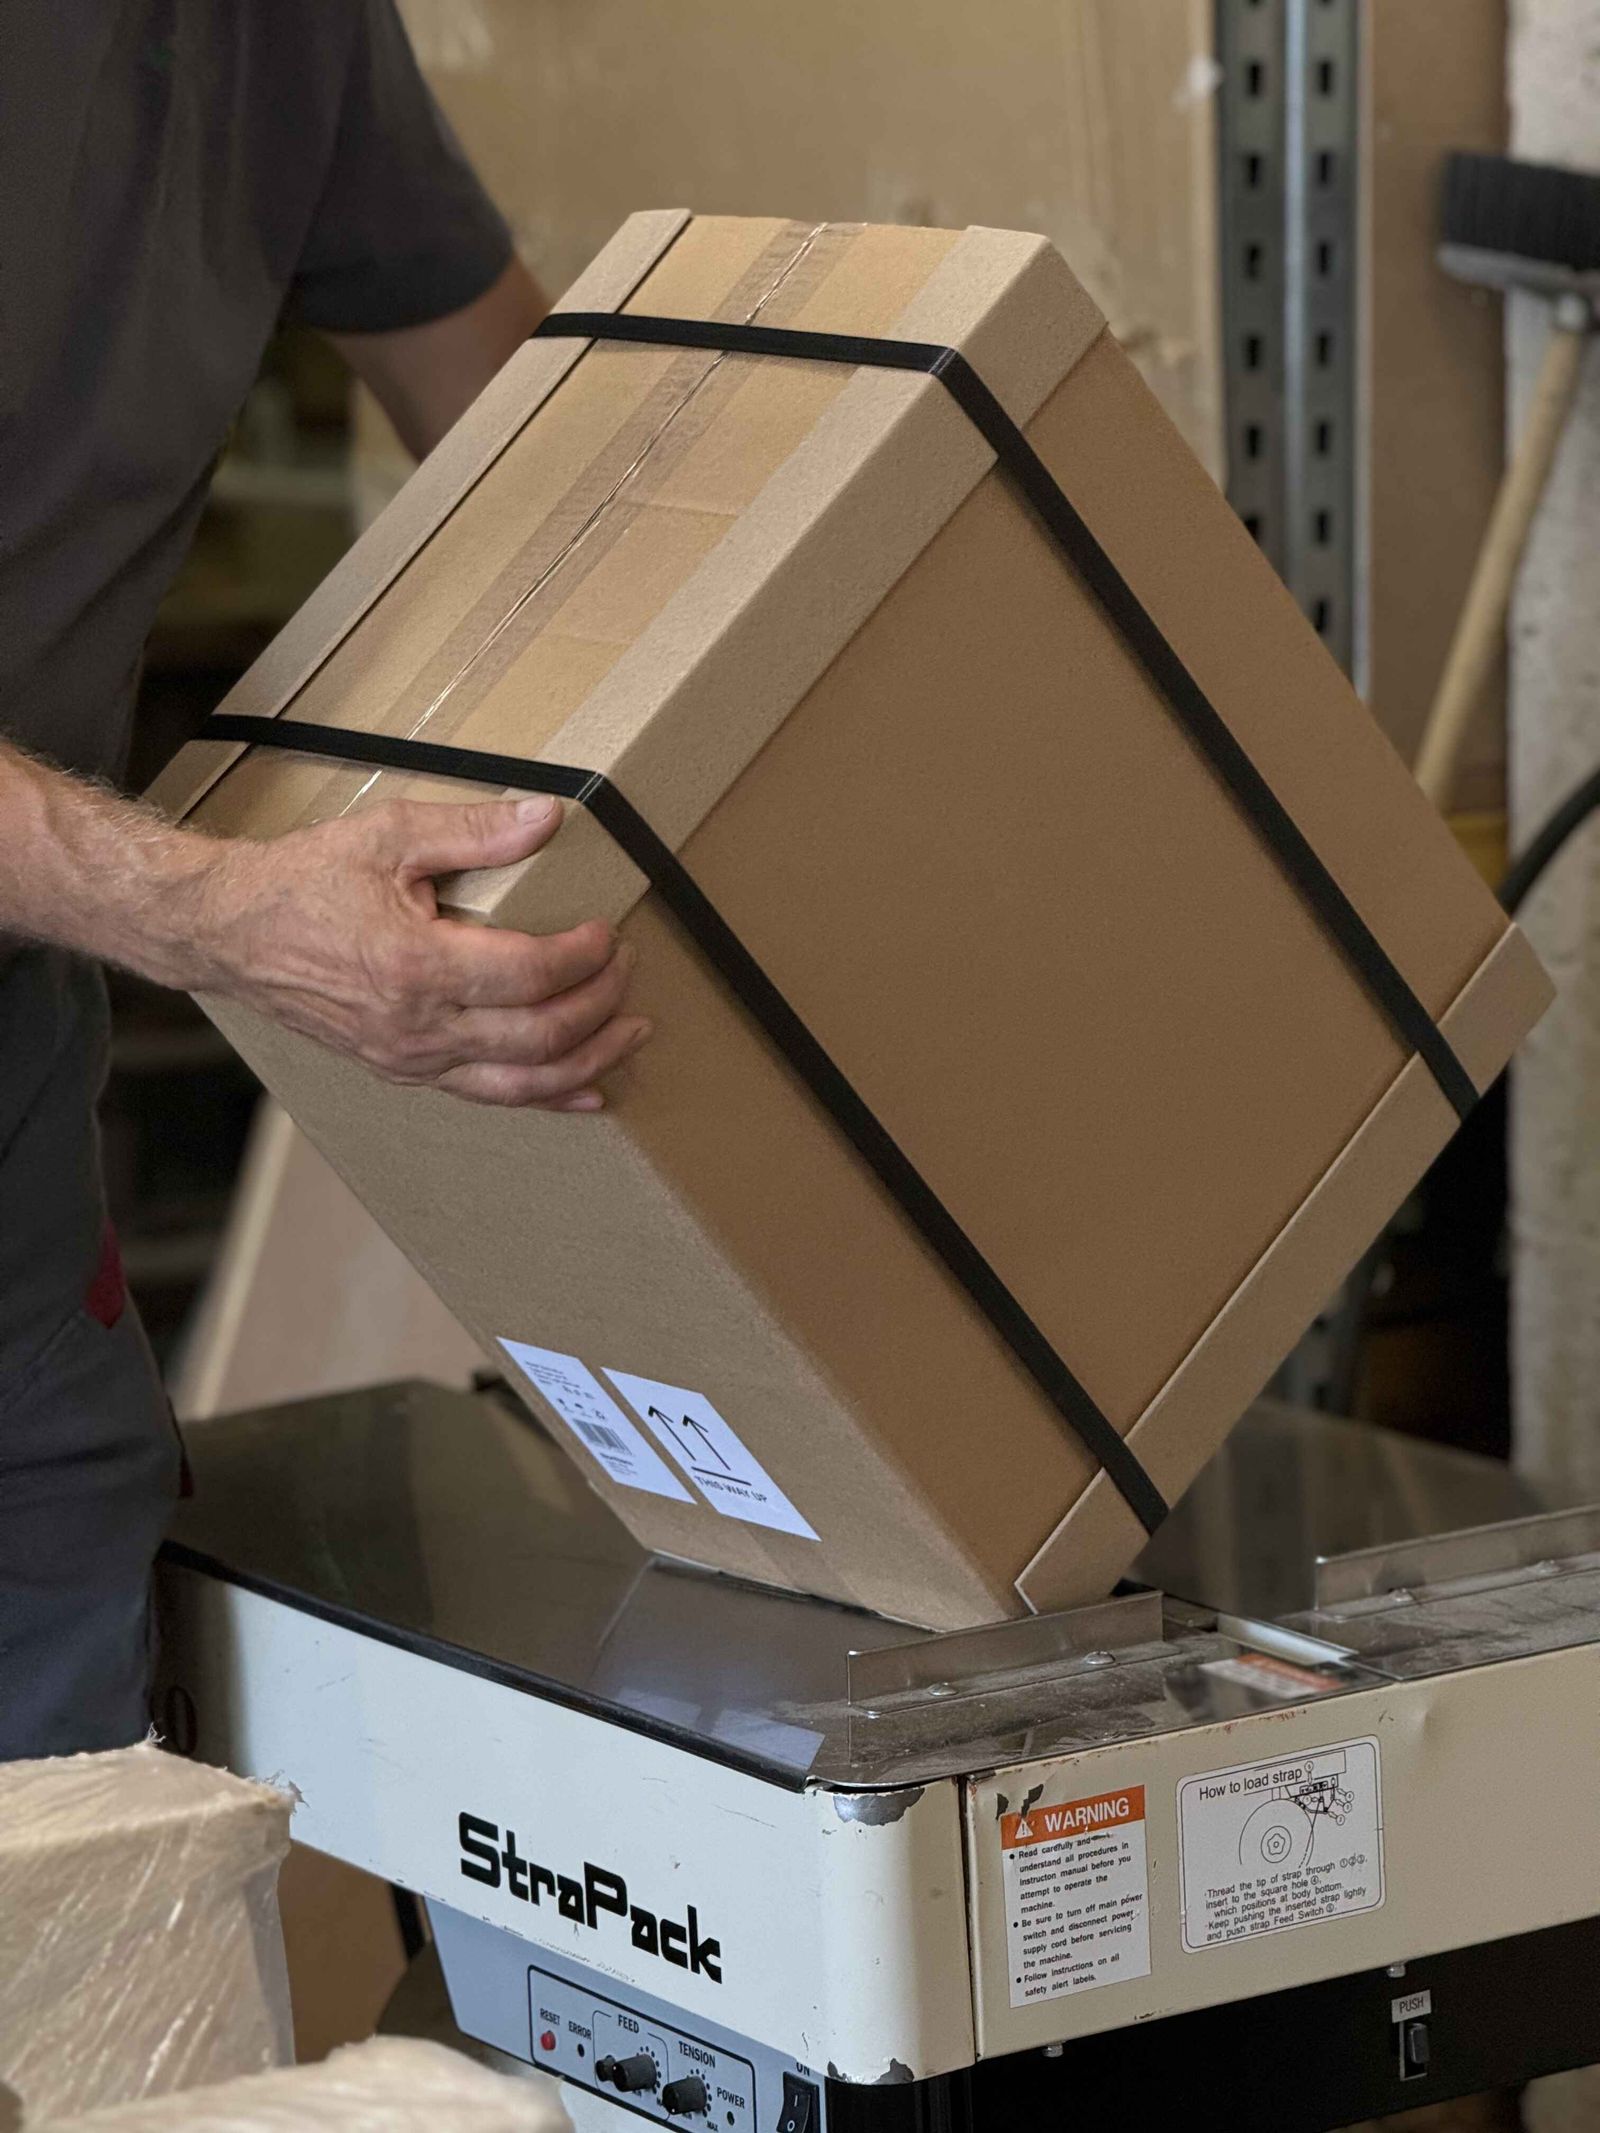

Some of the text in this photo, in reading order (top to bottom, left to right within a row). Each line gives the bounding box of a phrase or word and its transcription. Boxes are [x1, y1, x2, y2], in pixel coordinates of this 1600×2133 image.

[694, 1475, 767, 1503] THIS WAY UP
[1200, 1768, 1302, 1800] How to load strap
[1044, 1798, 1129, 1832] WARNING
[1018, 1836, 1091, 1860] Read carefully and
[1020, 1842, 1129, 1873] understand all procedures in
[1060, 1866, 1088, 1878] manual
[1092, 1858, 1114, 1870] before
[1118, 1855, 1132, 1866] you
[1240, 1882, 1252, 1891] the
[1256, 1878, 1266, 1888] tip
[1270, 1873, 1278, 1884] of
[1282, 1870, 1302, 1881] strap
[1306, 1862, 1336, 1876] through
[459, 1811, 722, 1984] StraPack
[1020, 1874, 1108, 1900] attempt to operate the
[1206, 1897, 1228, 1909] insert
[1244, 1892, 1256, 1900] the
[1261, 1884, 1288, 1897] square
[1292, 1879, 1308, 1889] hole
[1021, 1901, 1056, 1914] machine.
[1022, 1893, 1143, 1928] Be sure to turn off main power
[1214, 1906, 1238, 1918] which
[1242, 1898, 1276, 1913] positions
[1280, 1894, 1288, 1902] at
[1292, 1889, 1311, 1900] body
[1234, 1911, 1265, 1926] pushing
[1268, 1907, 1281, 1916] the
[1286, 1898, 1316, 1912] inserted
[1320, 1894, 1340, 1904] strap
[1344, 1887, 1366, 1900] lightly
[1023, 1930, 1046, 1942] switch
[1050, 1926, 1064, 1936] and
[1068, 1916, 1108, 1932] disconnect
[1206, 1932, 1222, 1941] and
[1226, 1926, 1246, 1938] push
[1250, 1921, 1270, 1931] strap
[1274, 1914, 1294, 1925] Feed
[1298, 1908, 1324, 1919] Switch
[1024, 1924, 1132, 1956] supply cord before servicing
[1024, 1952, 1072, 1969] the machine.
[1024, 1953, 1120, 1983] Follow instructions on all
[1025, 1974, 1096, 1998] safety alert labels.
[540, 2008, 560, 2025] RESET
[1399, 1996, 1424, 2014] PUSH
[568, 2020, 592, 2040] ERROR
[618, 2014, 640, 2034] FEED
[678, 2041, 716, 2068] TENSION
[796, 2061, 810, 2076] ON
[716, 2087, 745, 2109] POWER
[706, 2120, 718, 2132] MAX
